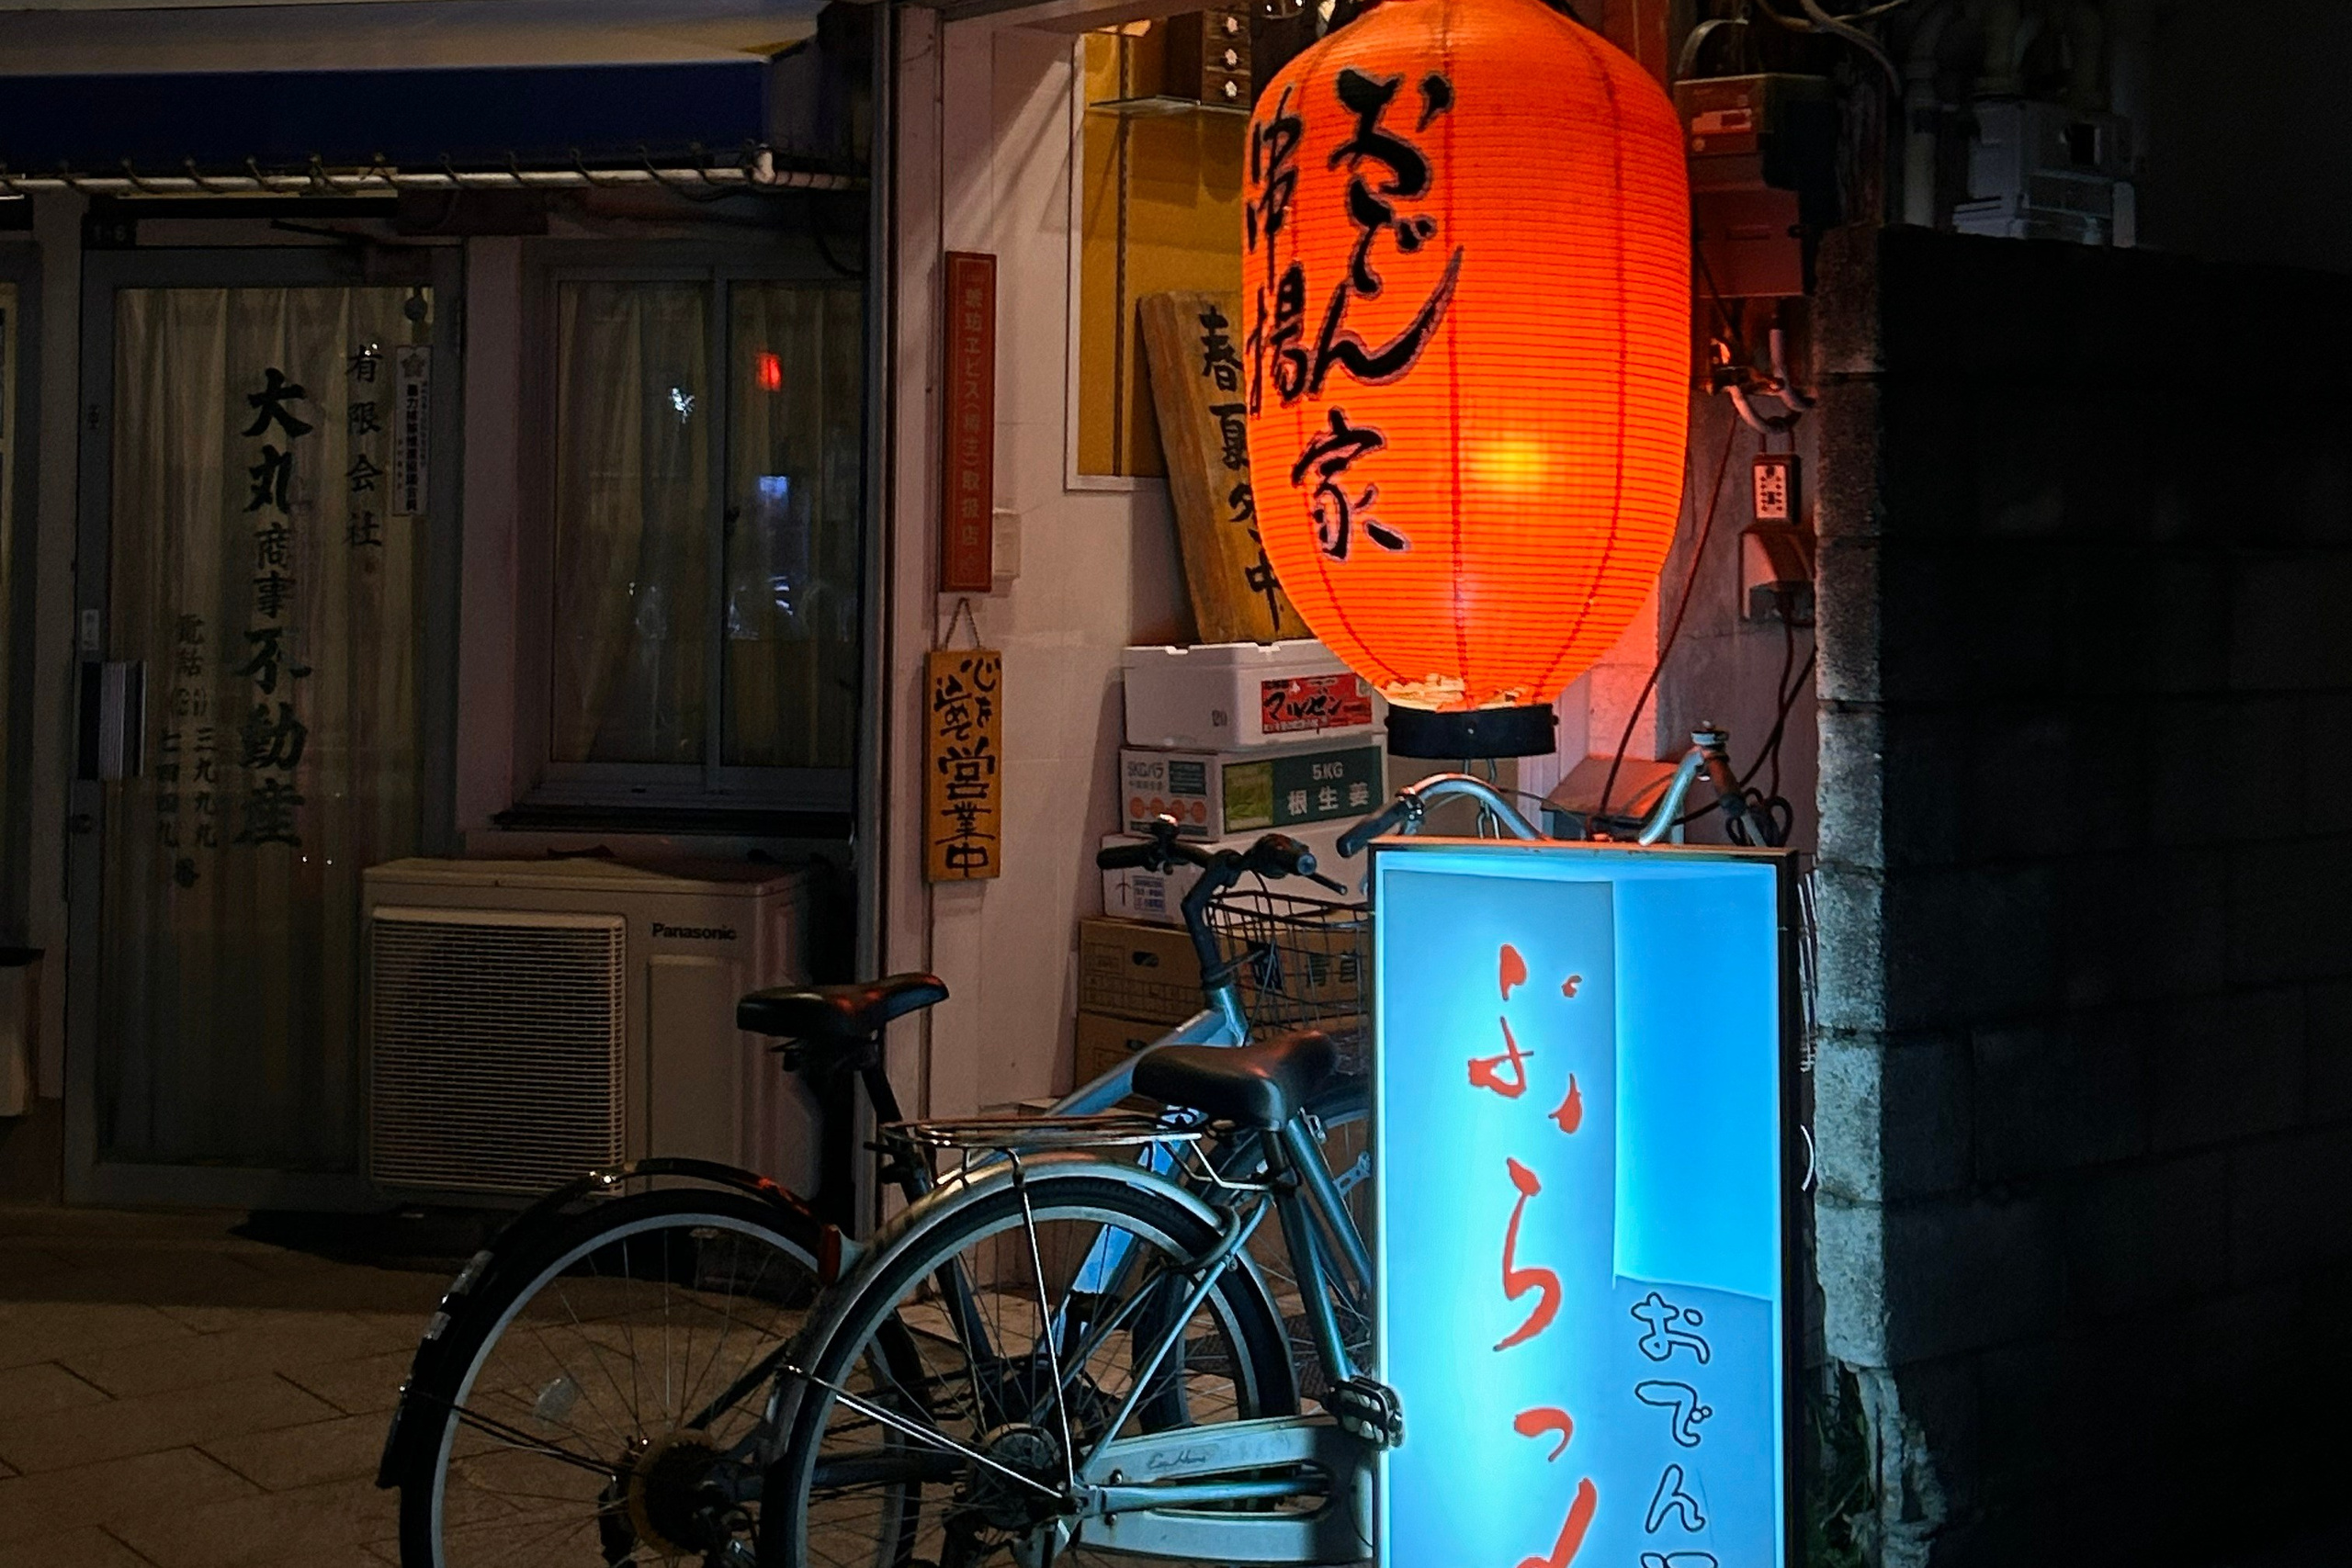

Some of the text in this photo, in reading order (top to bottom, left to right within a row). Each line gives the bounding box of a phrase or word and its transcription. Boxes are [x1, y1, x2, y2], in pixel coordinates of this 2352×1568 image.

[345, 344, 383, 547] 有限会社
[234, 367, 313, 848] 大丸商事不動産
[1312, 761, 1344, 780] 5KG
[652, 923, 737, 941] Panasonic
[1632, 1291, 1718, 1568] おでん
